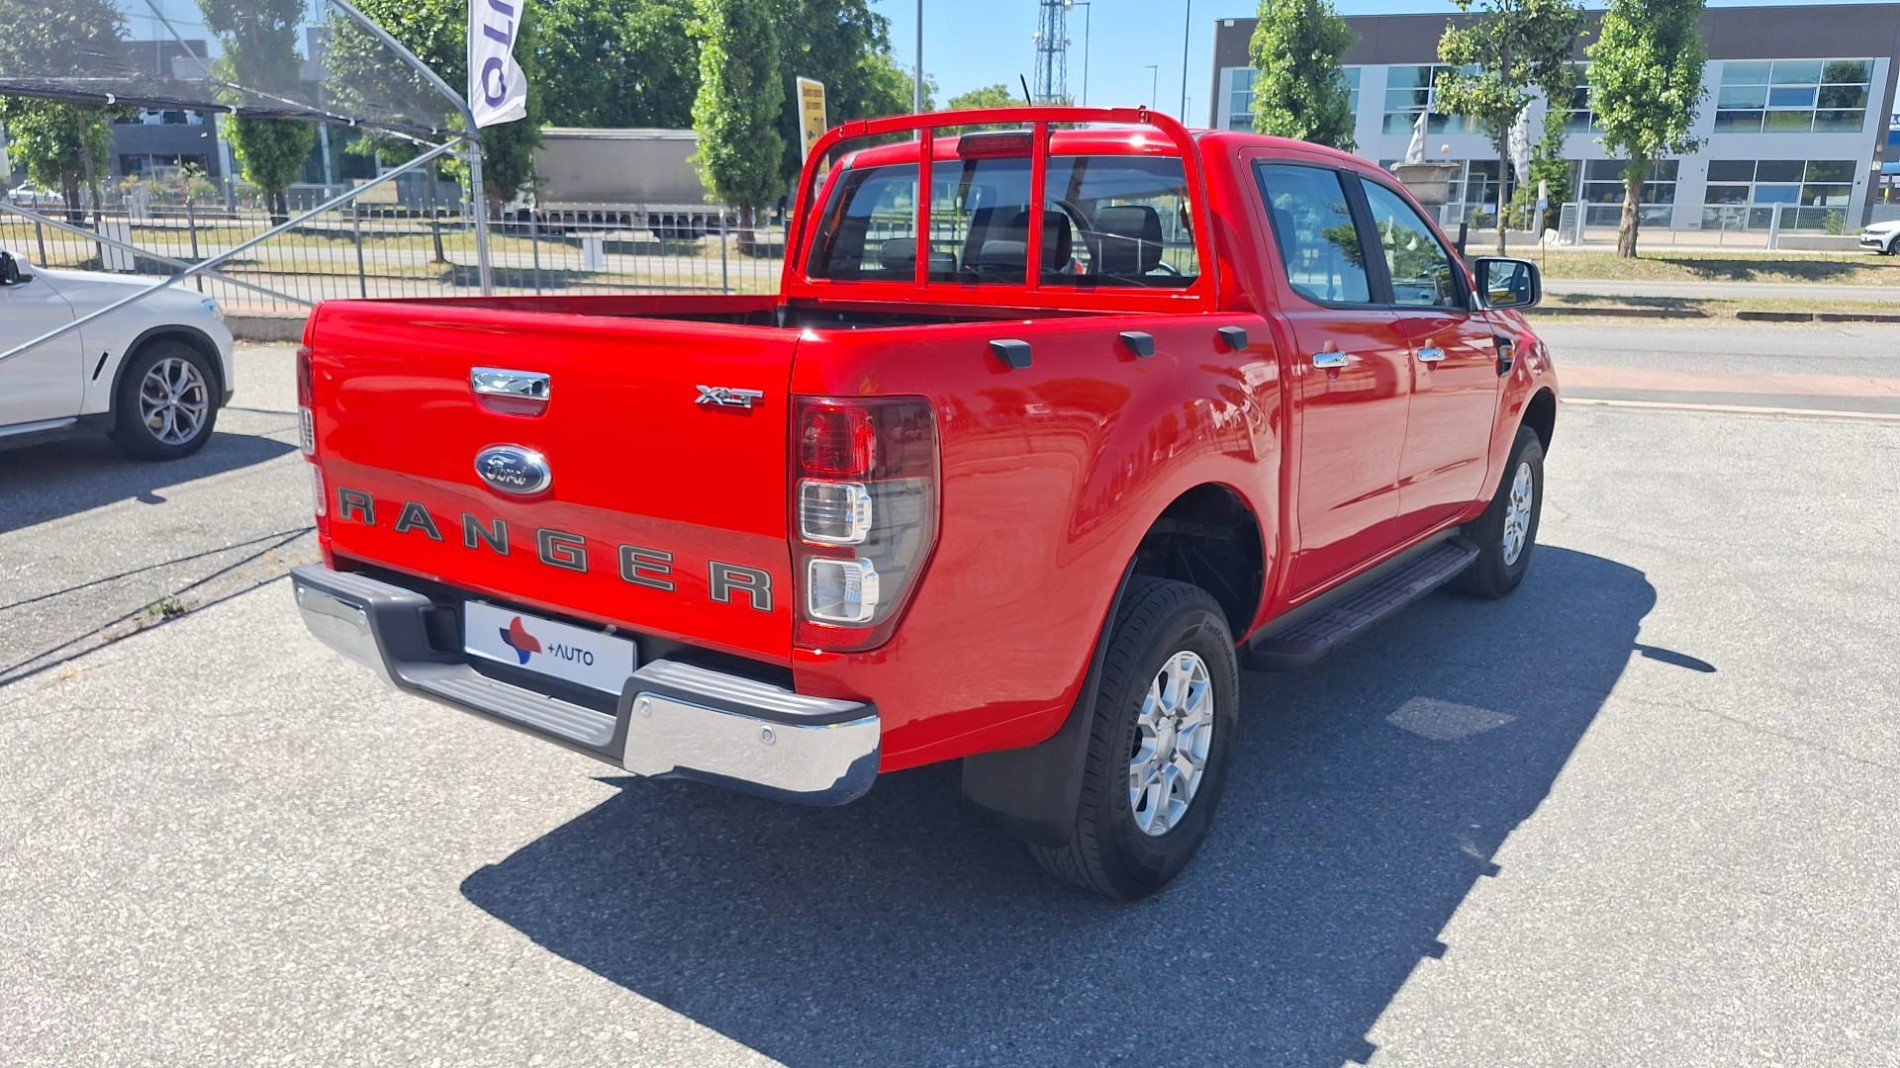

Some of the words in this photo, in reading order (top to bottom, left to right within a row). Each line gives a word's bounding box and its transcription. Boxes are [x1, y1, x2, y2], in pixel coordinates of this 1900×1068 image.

[694, 384, 764, 408] XLT
[485, 454, 527, 486] Ford
[337, 486, 773, 613] RANGER
